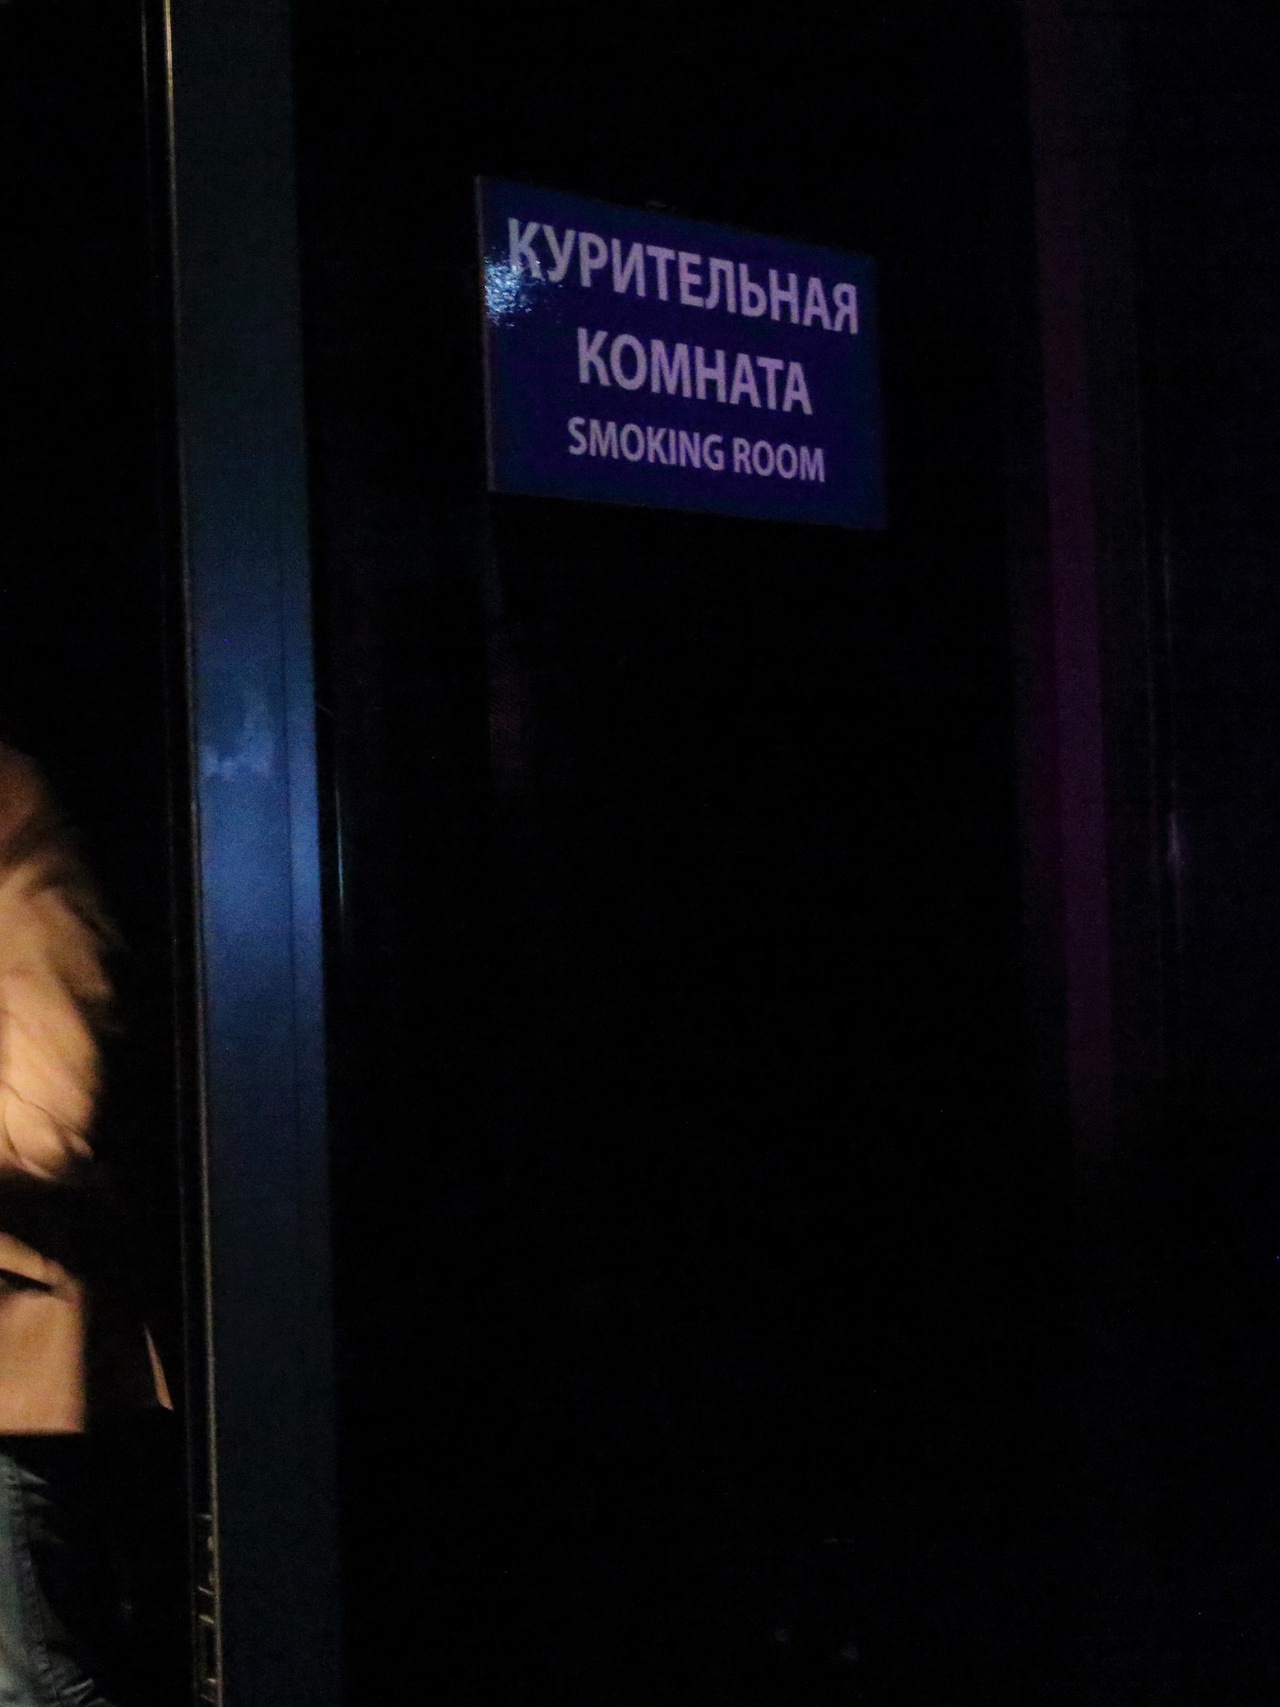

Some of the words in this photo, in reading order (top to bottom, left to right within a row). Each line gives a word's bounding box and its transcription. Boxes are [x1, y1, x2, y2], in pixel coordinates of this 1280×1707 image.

[507, 217, 859, 335] КУРИТЕЛЬНАЯ
[577, 327, 813, 416] КОМНАТА
[567, 415, 726, 472] SMOKING
[732, 436, 826, 483] ROOM
